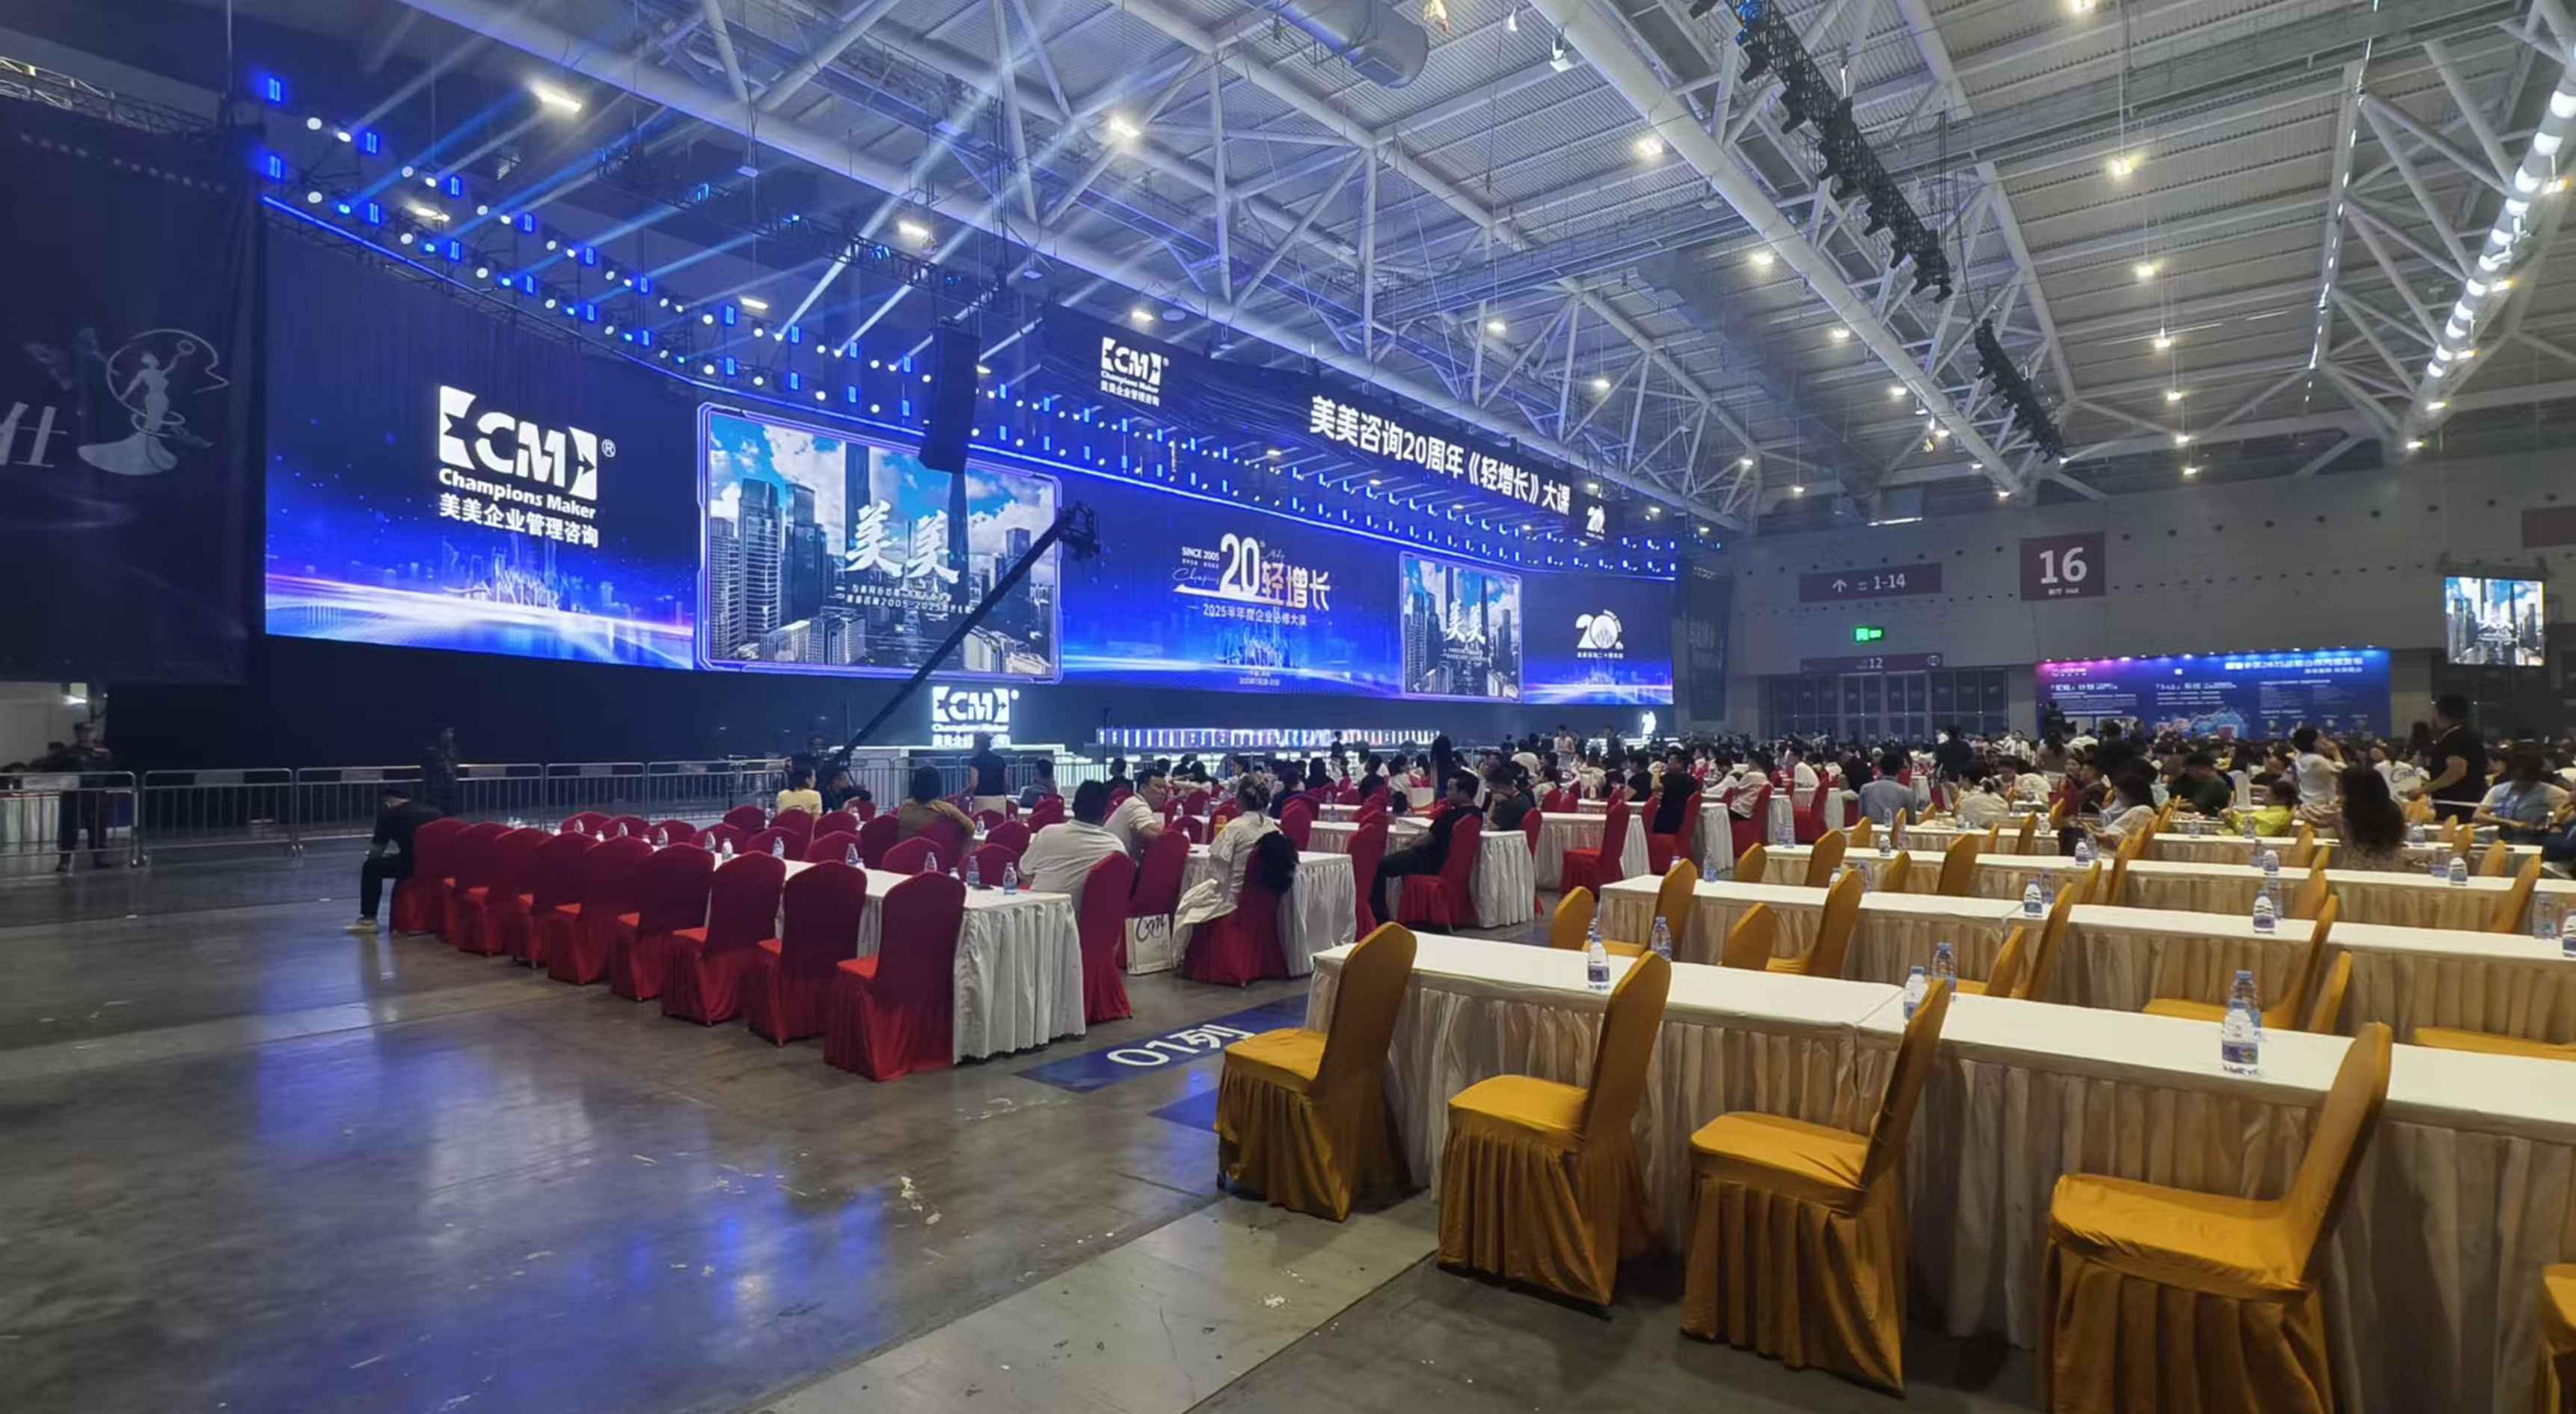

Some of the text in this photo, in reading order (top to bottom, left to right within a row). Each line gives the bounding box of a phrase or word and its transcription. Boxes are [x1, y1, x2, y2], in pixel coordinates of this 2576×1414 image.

[1310, 396, 1571, 516] 美美咨询20周年《轻增长》大课
[439, 468, 597, 520] Champions Maker
[439, 492, 599, 548] 美美企业管理咨询
[1261, 560, 1331, 611] 轻增长
[1874, 573, 1907, 590] 1-14
[2040, 547, 2088, 584] 16
[1869, 657, 1884, 670] 12
